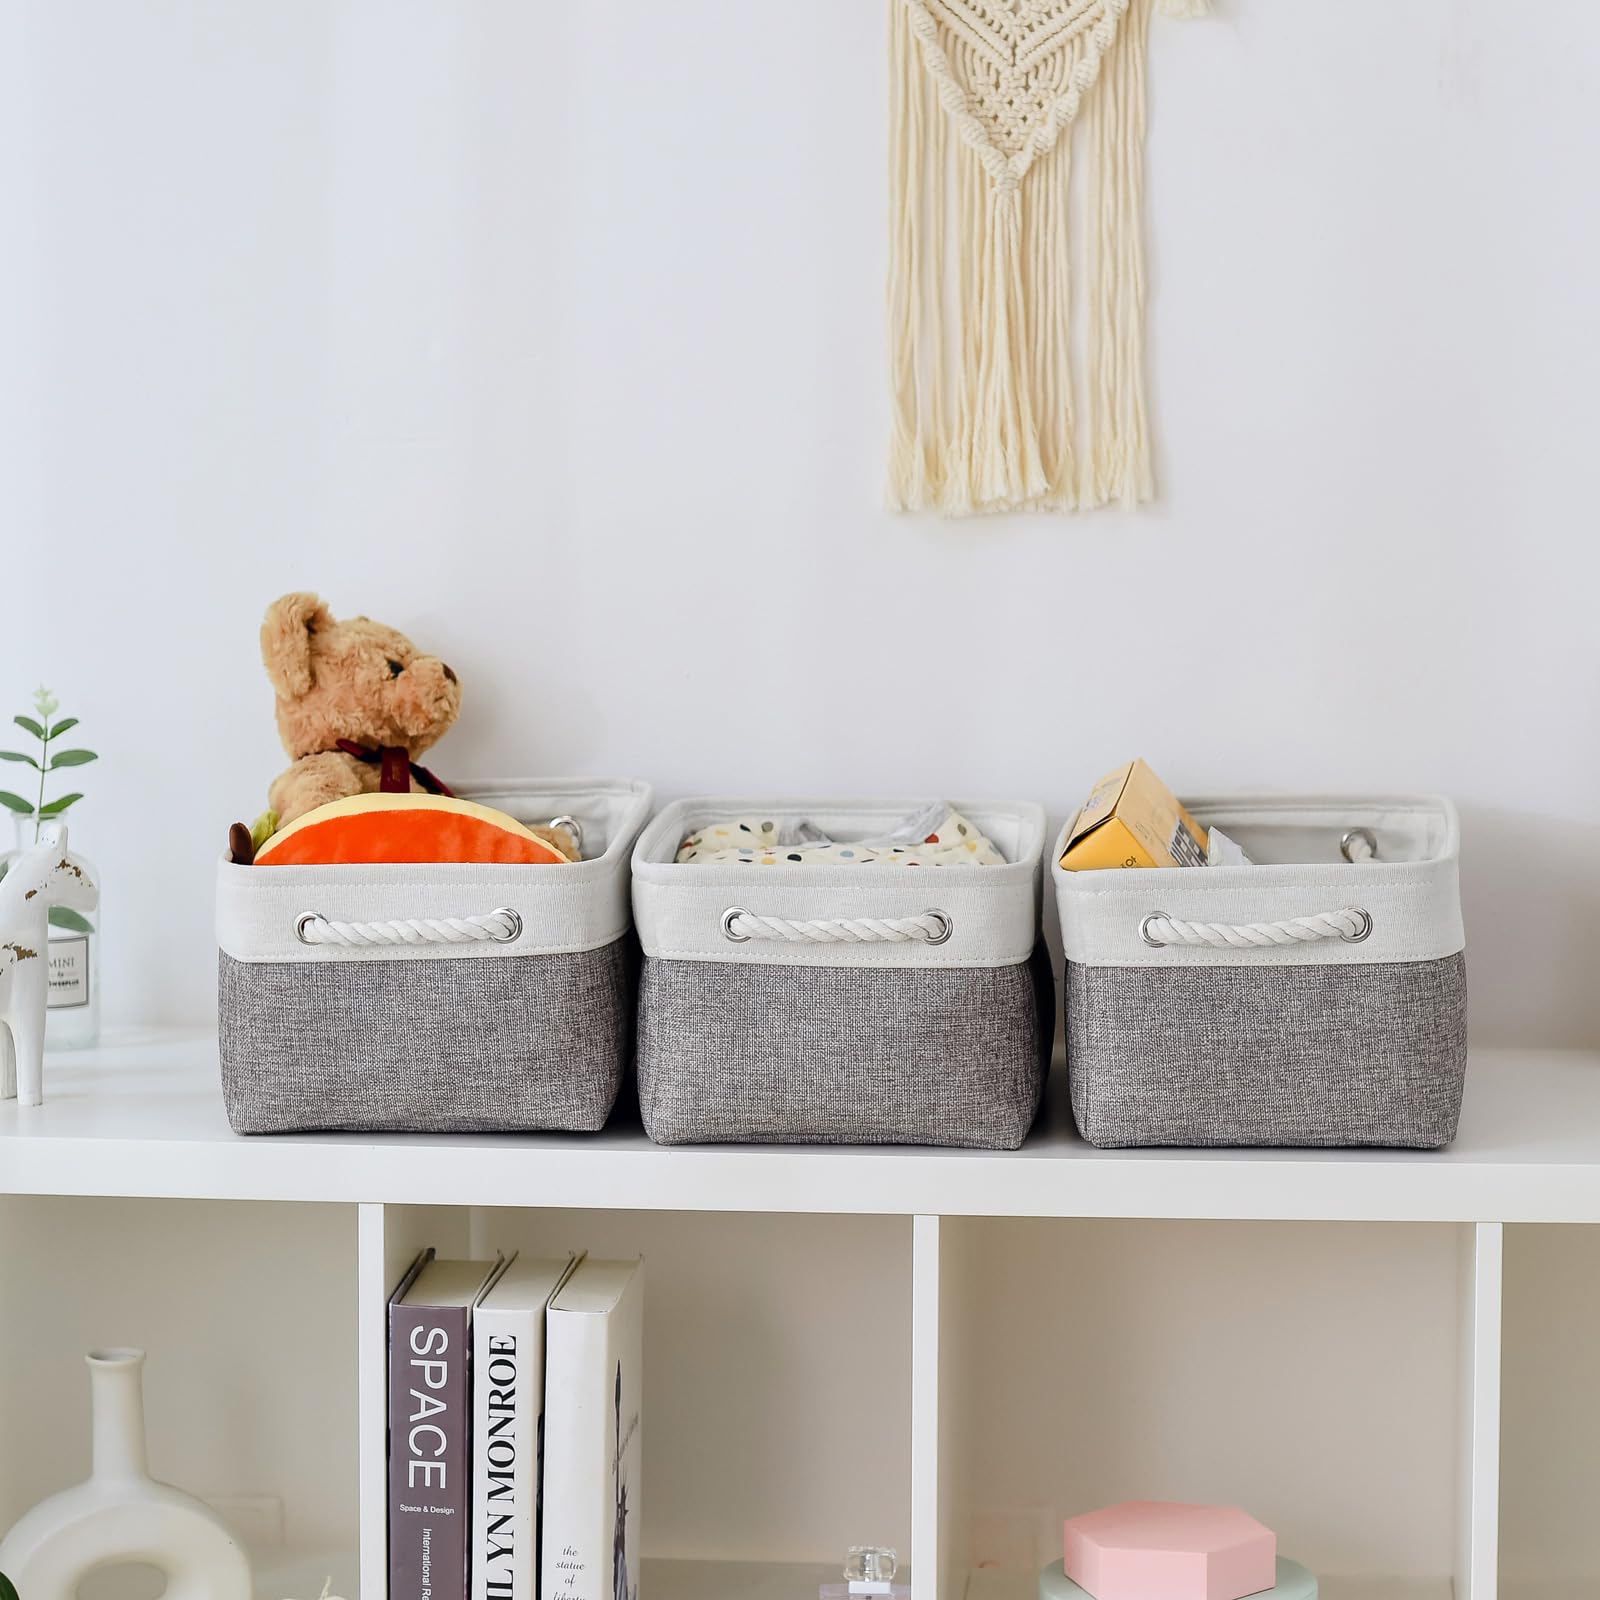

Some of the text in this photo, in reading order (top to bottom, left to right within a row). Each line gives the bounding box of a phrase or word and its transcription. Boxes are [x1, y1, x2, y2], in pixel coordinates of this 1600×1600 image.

[409, 1325, 449, 1489] SPACE
[487, 1335, 517, 1505] MONROE
[400, 1504, 422, 1513] Space
[430, 1506, 455, 1516] Design
[422, 1528, 433, 1587] International
[563, 1545, 577, 1557] the
[556, 1561, 585, 1570] statue
[564, 1574, 575, 1588] of
